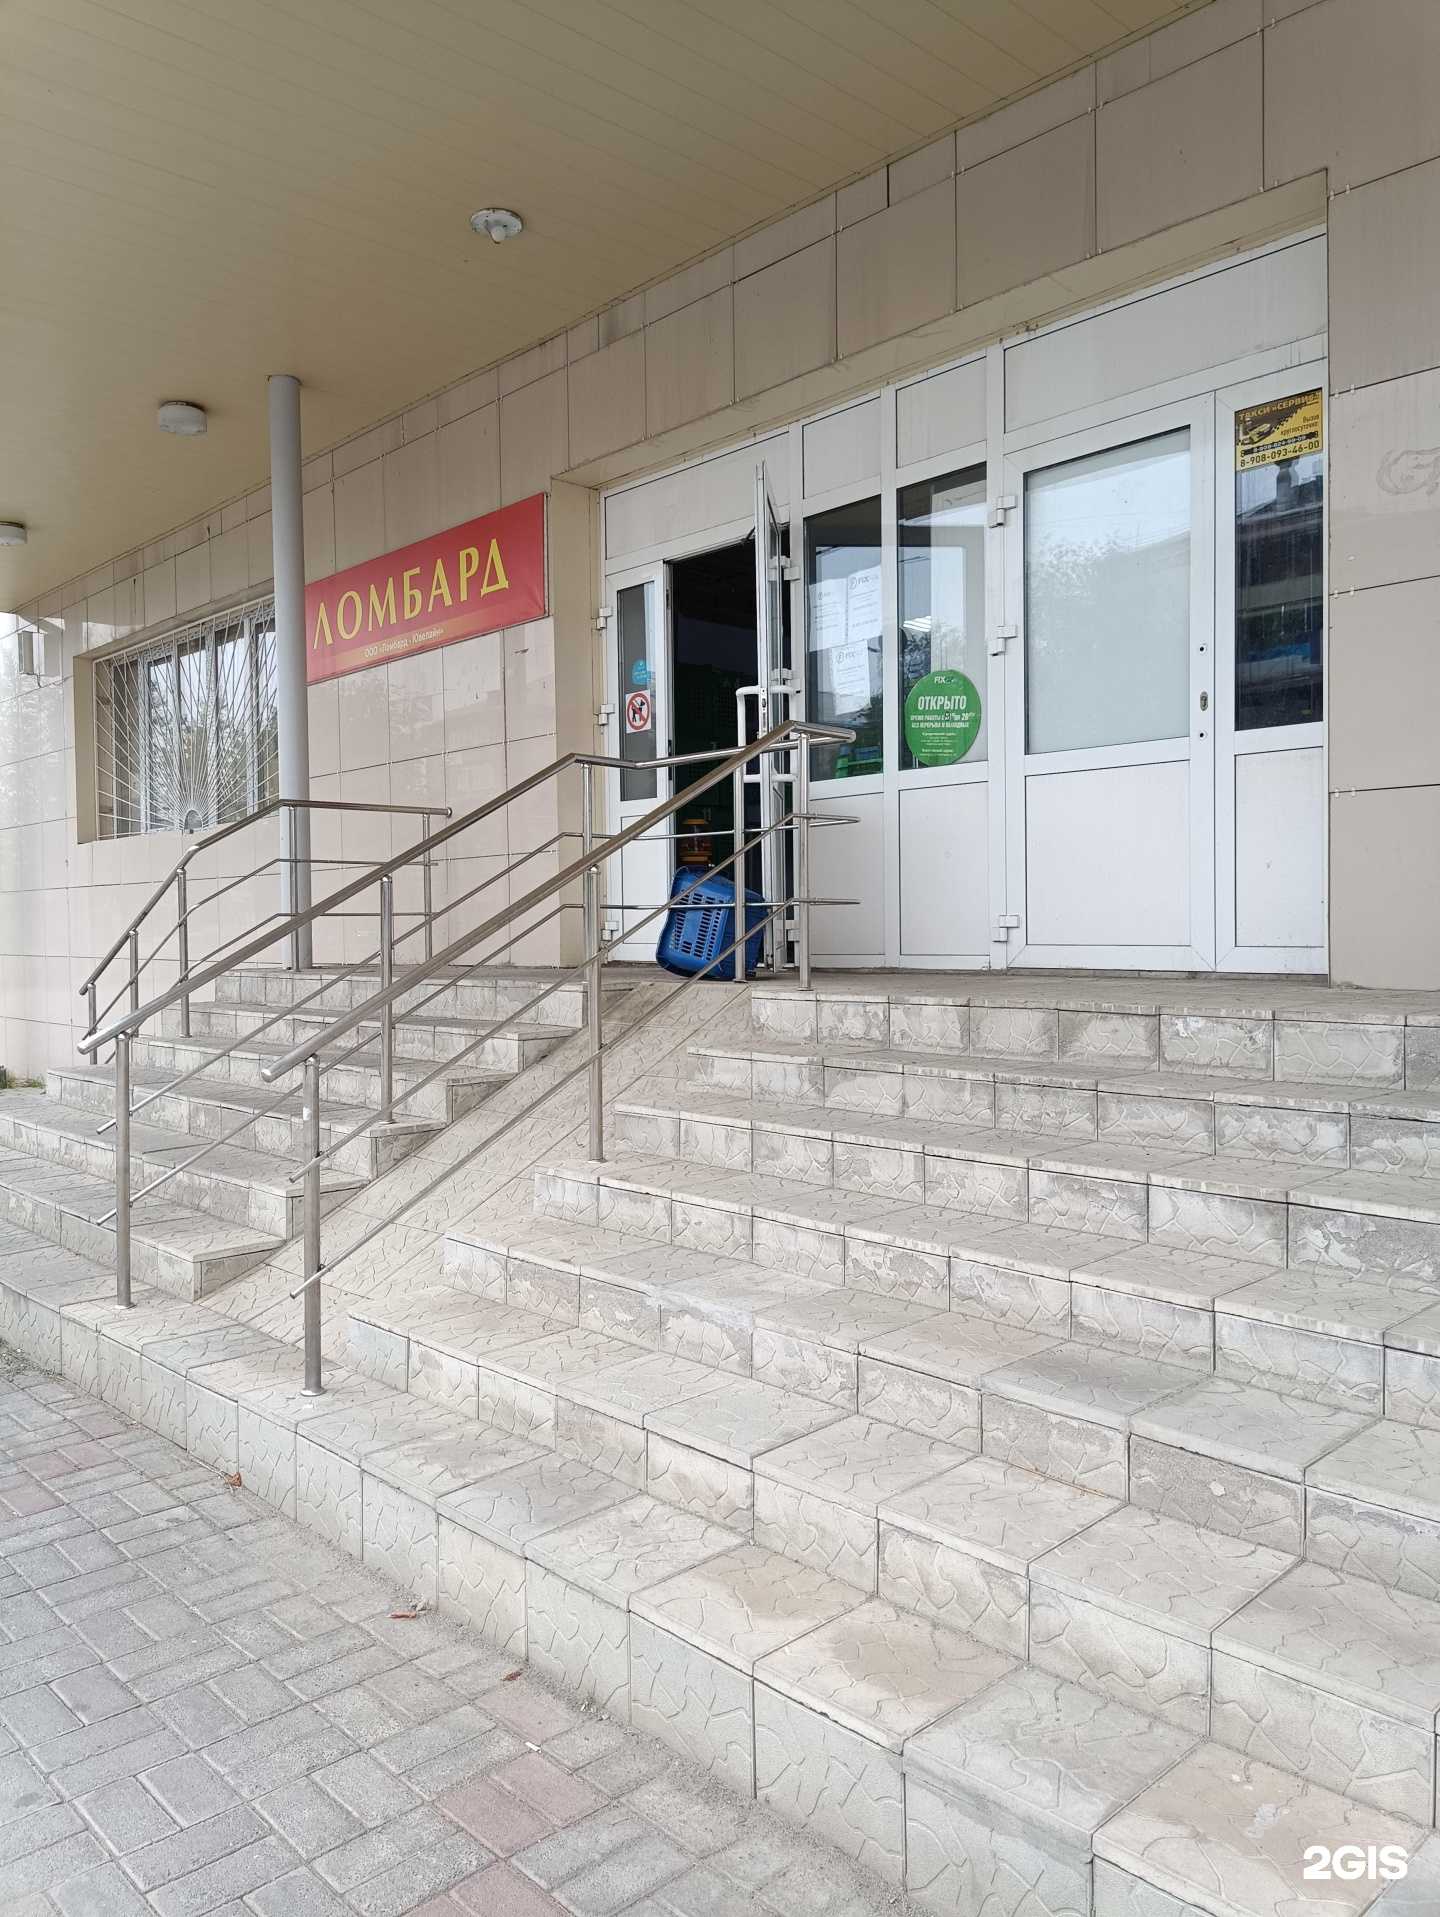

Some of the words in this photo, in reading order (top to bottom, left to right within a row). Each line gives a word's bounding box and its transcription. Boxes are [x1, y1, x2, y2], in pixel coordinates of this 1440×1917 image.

[1240, 440, 1320, 467] 8-908-093-46-00
[312, 537, 510, 650] ЛОМБАРД
[364, 646, 378, 658] ООО
[917, 695, 967, 710] ОТКРЫТО
